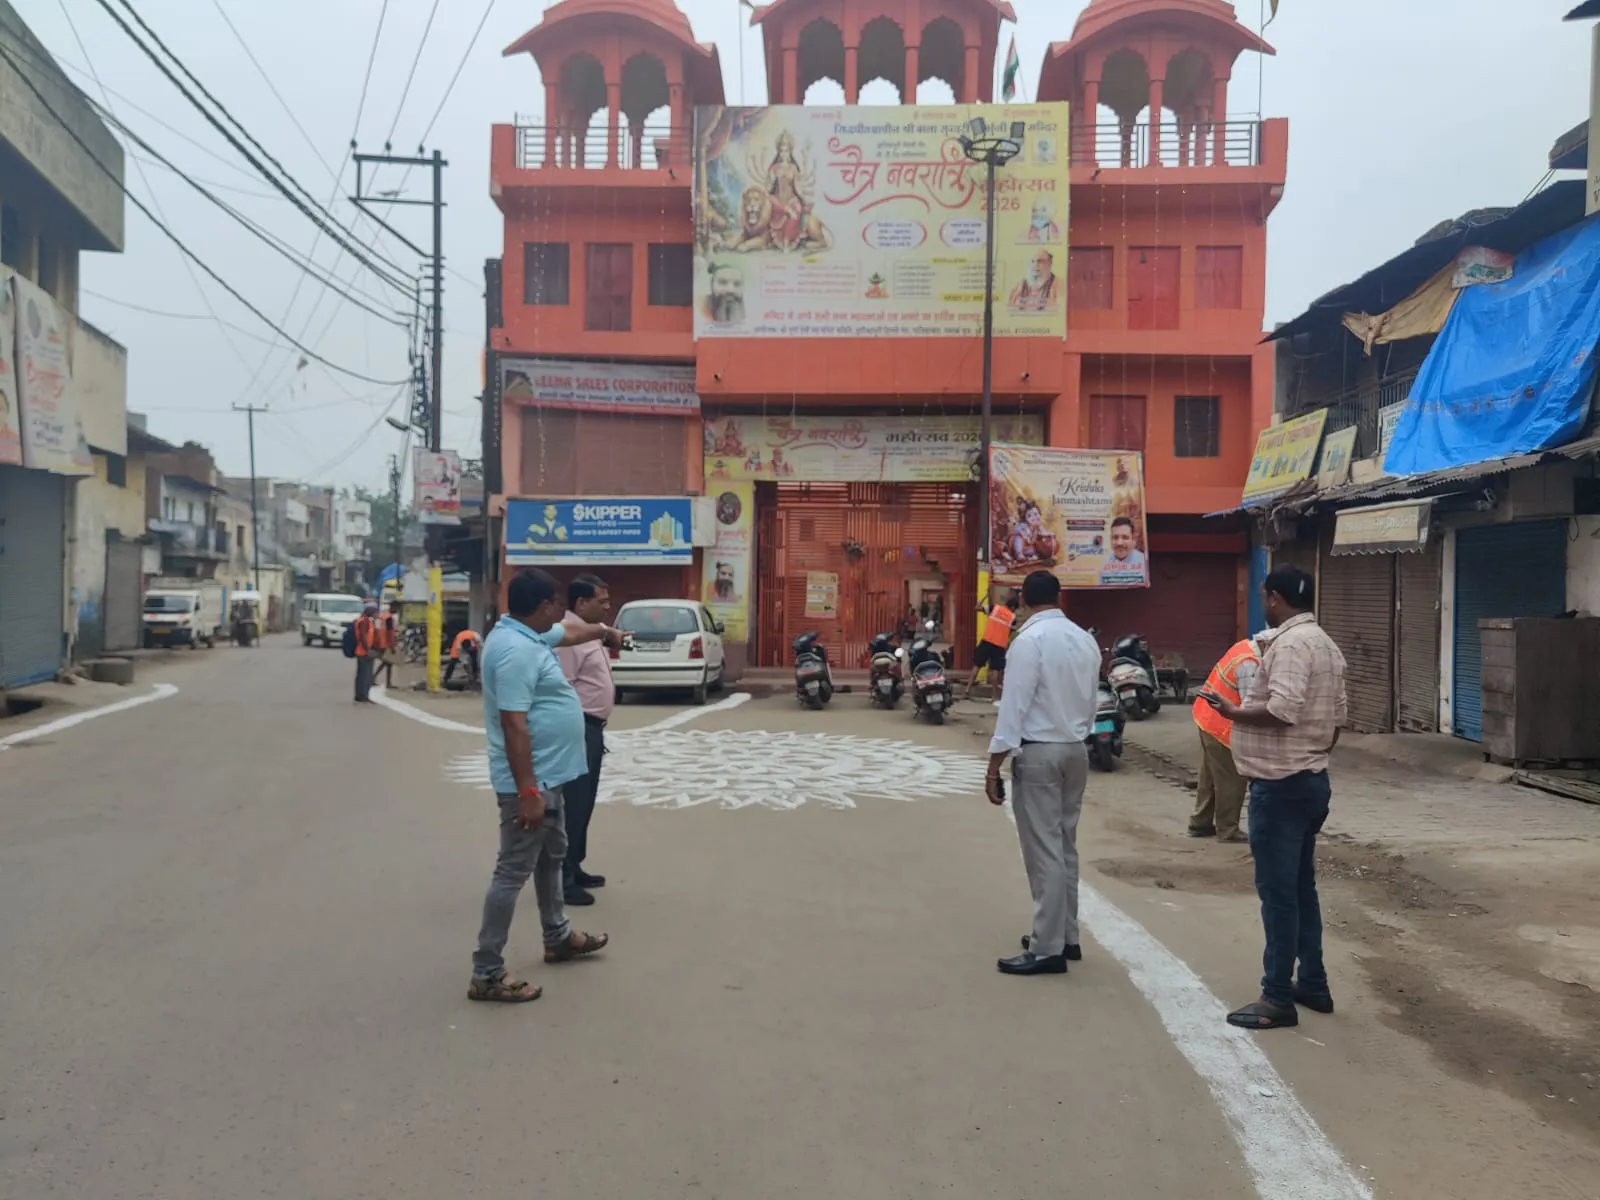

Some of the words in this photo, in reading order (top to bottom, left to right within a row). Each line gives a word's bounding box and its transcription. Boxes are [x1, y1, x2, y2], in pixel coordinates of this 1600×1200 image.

[825, 137, 881, 204] चैत्र
[886, 138, 978, 208] नवरात्रि
[979, 198, 1020, 212] 226
[612, 380, 696, 394] CORPORATION
[952, 431, 981, 443] 202
[572, 503, 642, 521] SKIPPER
